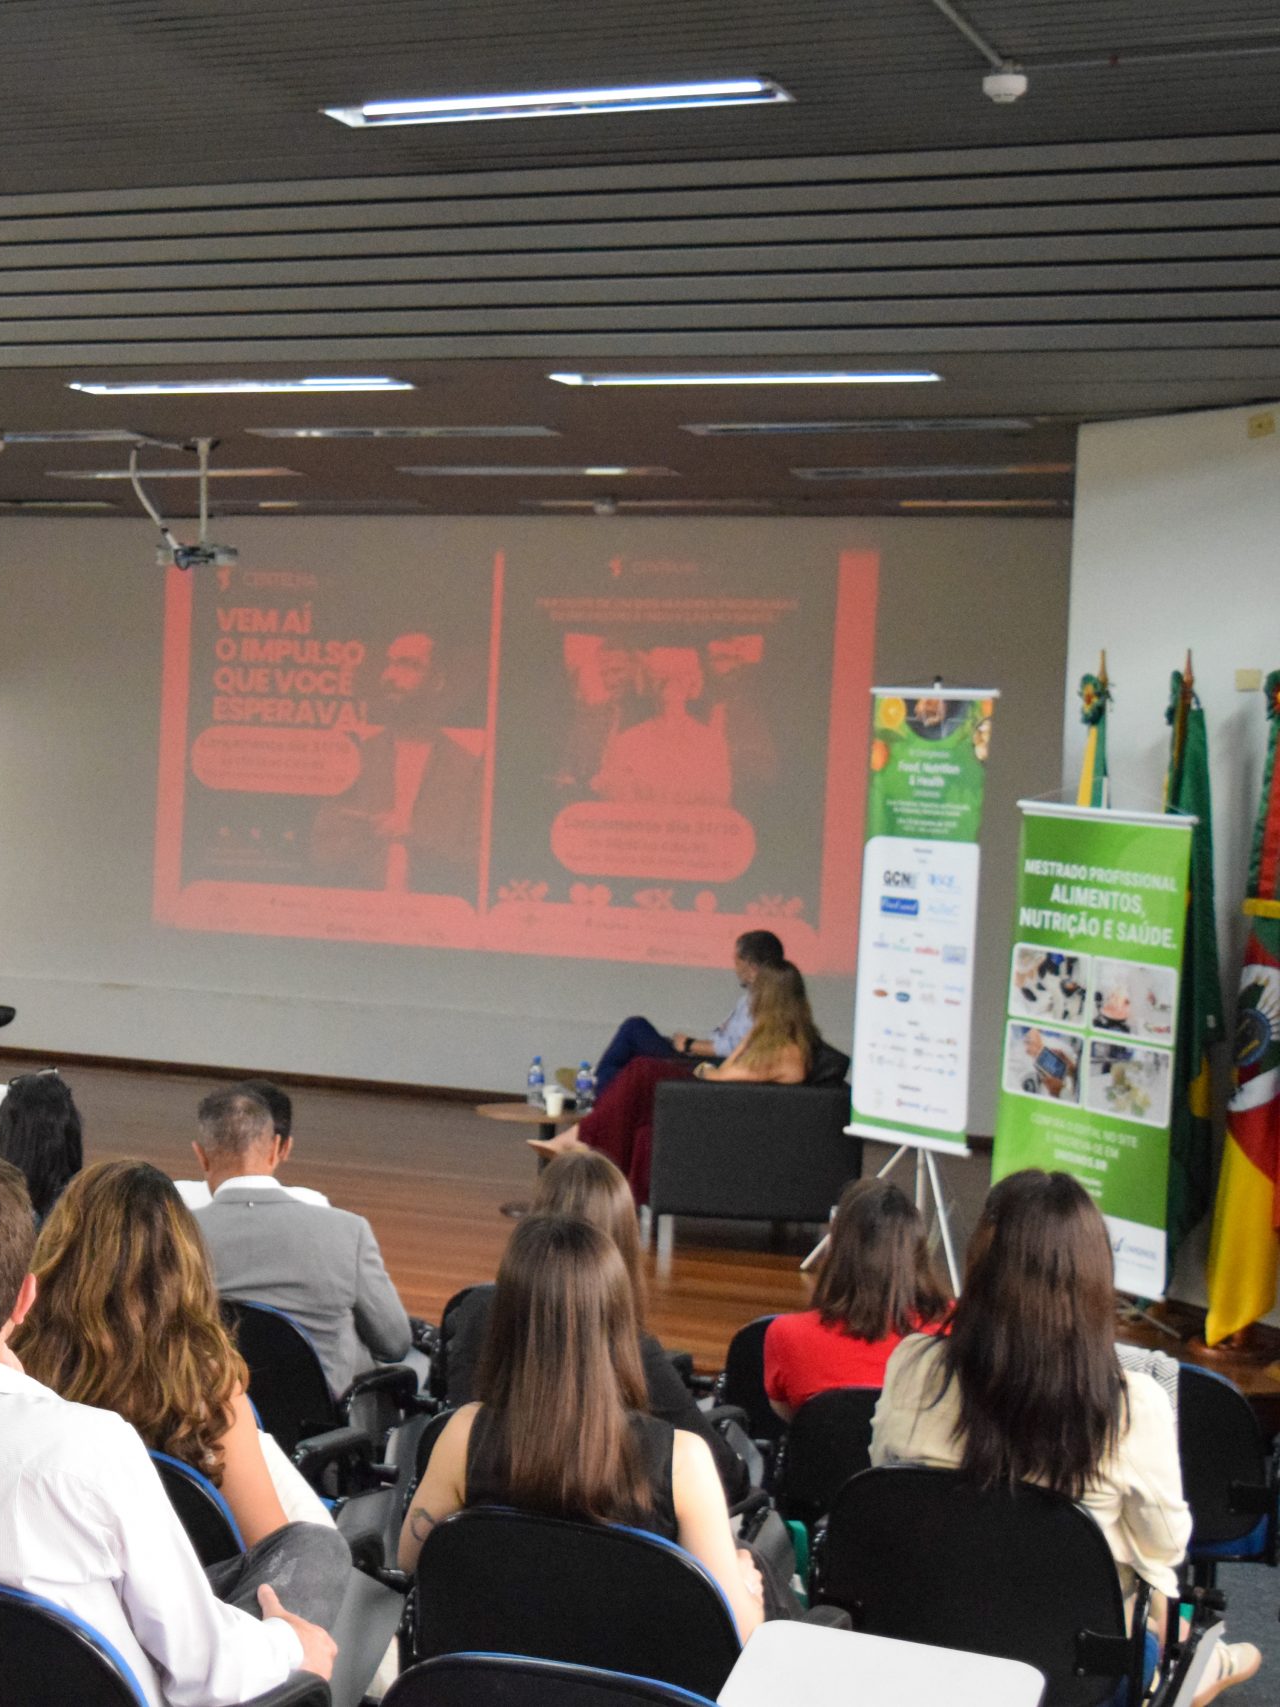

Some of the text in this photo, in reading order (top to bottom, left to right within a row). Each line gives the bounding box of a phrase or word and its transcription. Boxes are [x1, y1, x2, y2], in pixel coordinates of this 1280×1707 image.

[218, 607, 278, 633] VEM
[216, 639, 365, 665] O IMPULSO
[215, 669, 271, 694] QUE
[1024, 858, 1178, 893] MESTRADO PROFISSIONAL
[1050, 883, 1146, 917] ALIMENTOS,
[1019, 906, 1100, 939] NUTRIÇÃO
[1103, 918, 1113, 940] E
